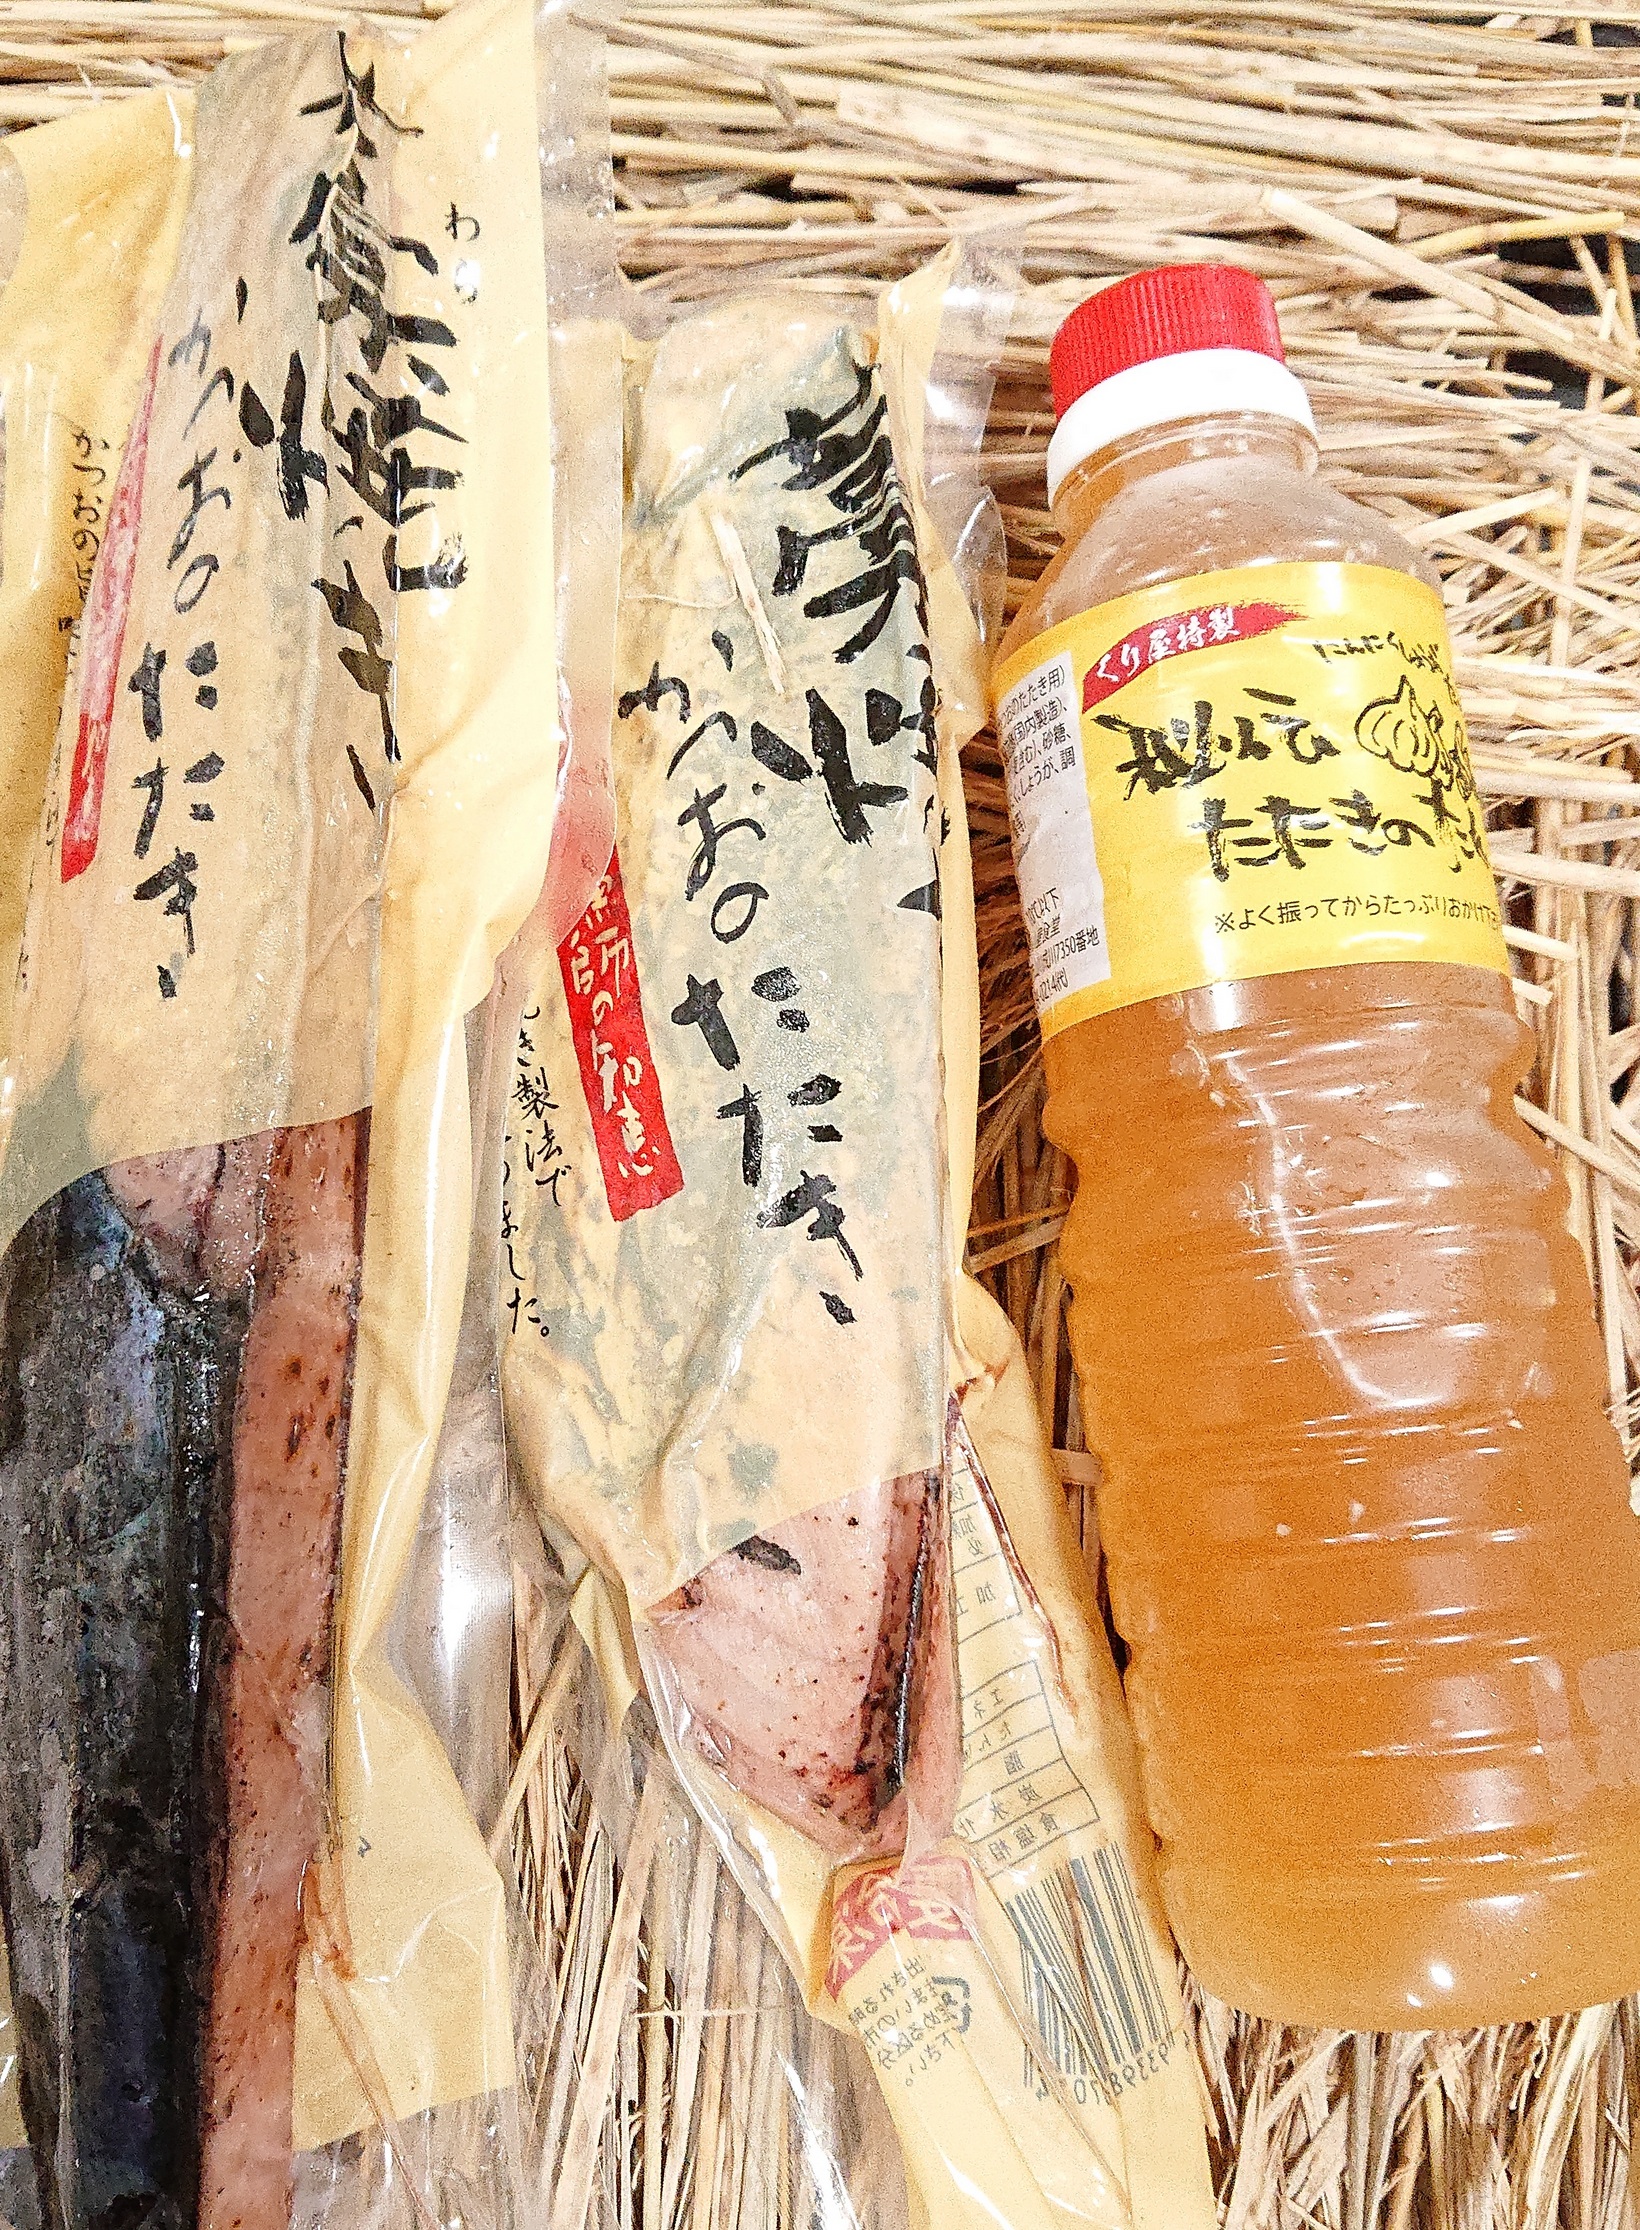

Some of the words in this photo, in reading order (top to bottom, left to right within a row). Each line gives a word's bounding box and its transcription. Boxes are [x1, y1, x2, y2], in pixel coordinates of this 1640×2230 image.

[1096, 606, 1242, 683] くり屋特製
[617, 630, 865, 1325] かつおのたたき
[511, 1005, 572, 1207] き製法で
